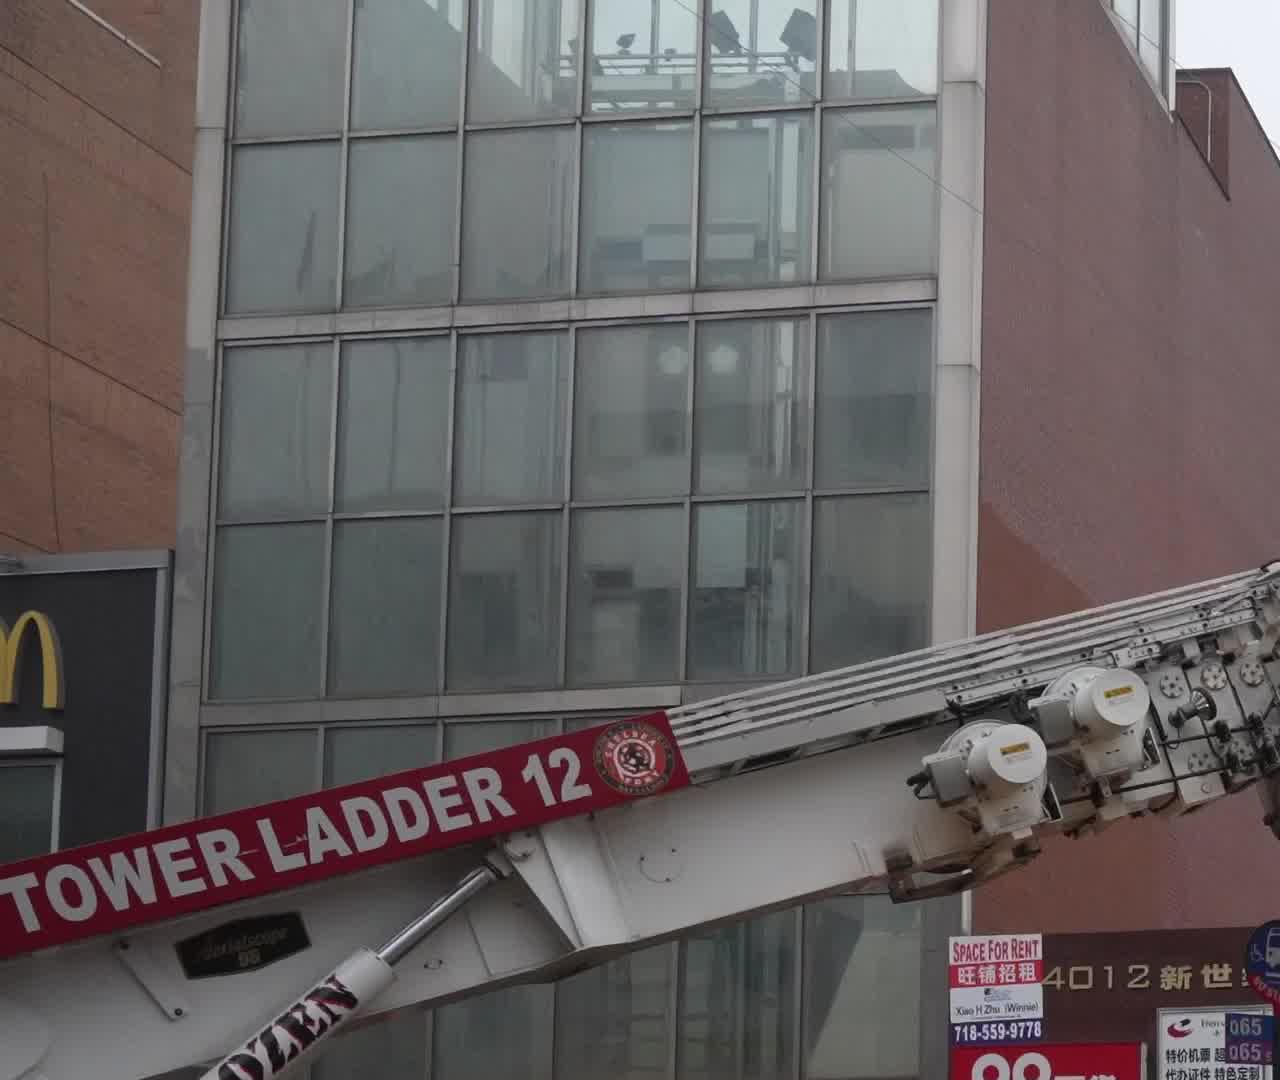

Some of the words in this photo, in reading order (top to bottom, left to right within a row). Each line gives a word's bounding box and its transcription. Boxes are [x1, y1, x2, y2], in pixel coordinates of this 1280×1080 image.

[0, 828, 256, 935] TOWER
[257, 767, 516, 874] LADDER
[521, 748, 592, 806] 12
[953, 940, 985, 962] SPACE
[988, 939, 1009, 961] FOR
[1011, 938, 1039, 959] RENT
[1041, 965, 1151, 990] 4012
[954, 1021, 1042, 1042] 718-559-9778
[1166, 1048, 1210, 1064] 特价机票
